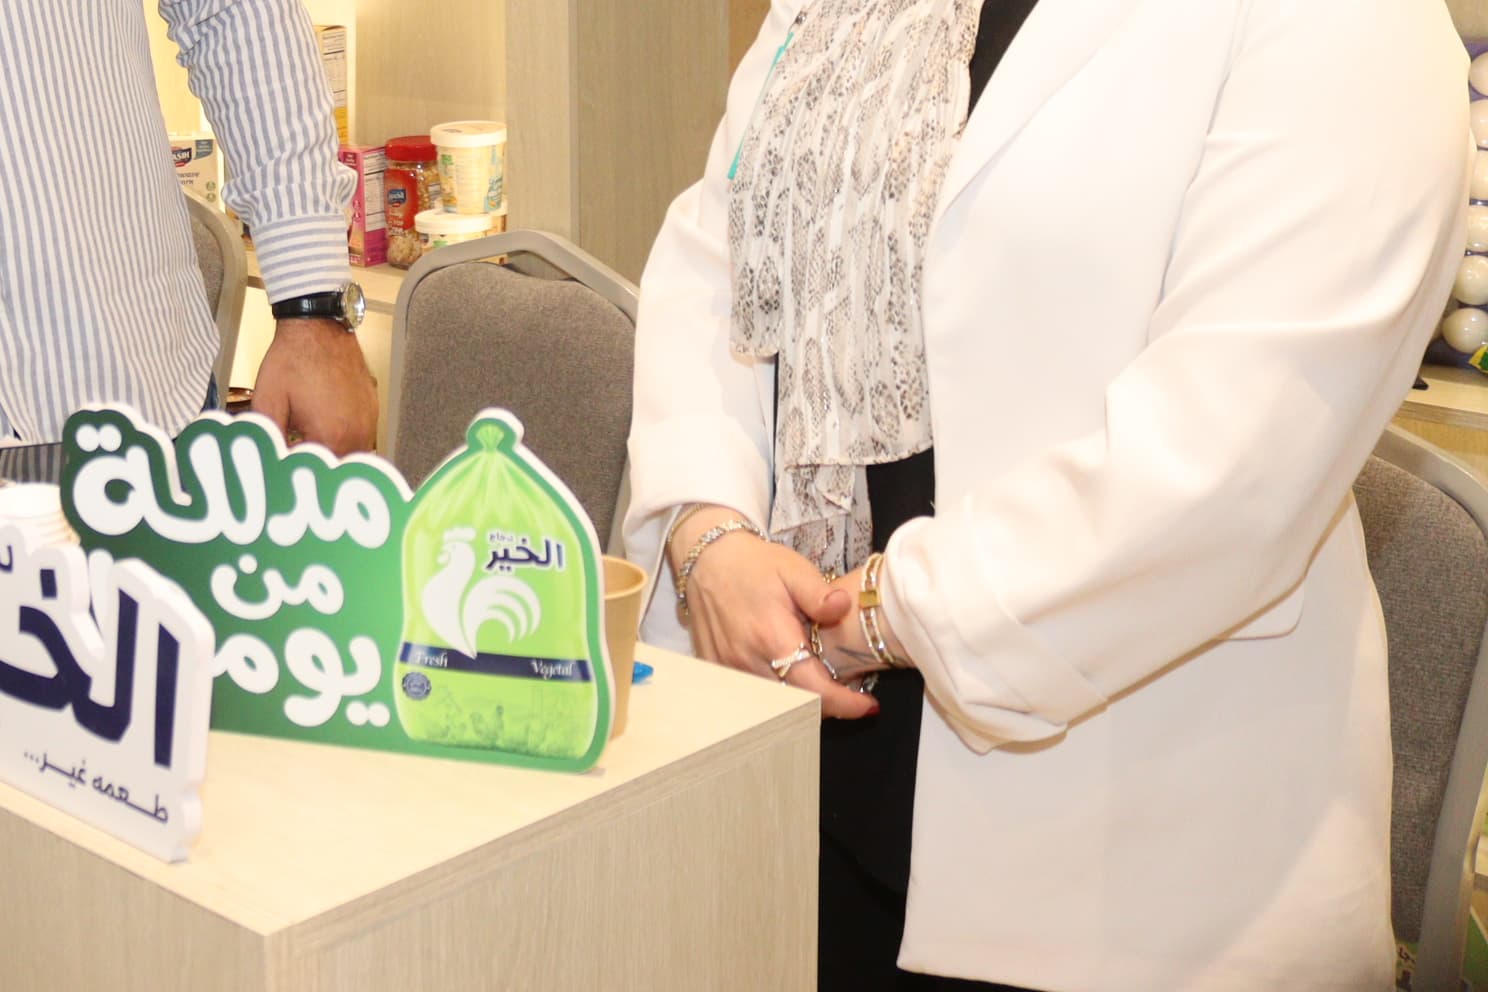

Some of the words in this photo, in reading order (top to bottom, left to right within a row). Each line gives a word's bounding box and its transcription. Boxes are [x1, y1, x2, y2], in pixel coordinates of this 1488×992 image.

[73, 424, 391, 549] مدللة
[486, 537, 564, 571] الخير
[210, 553, 344, 620] من
[416, 651, 449, 668] Fresh
[530, 659, 574, 681] Vegetal
